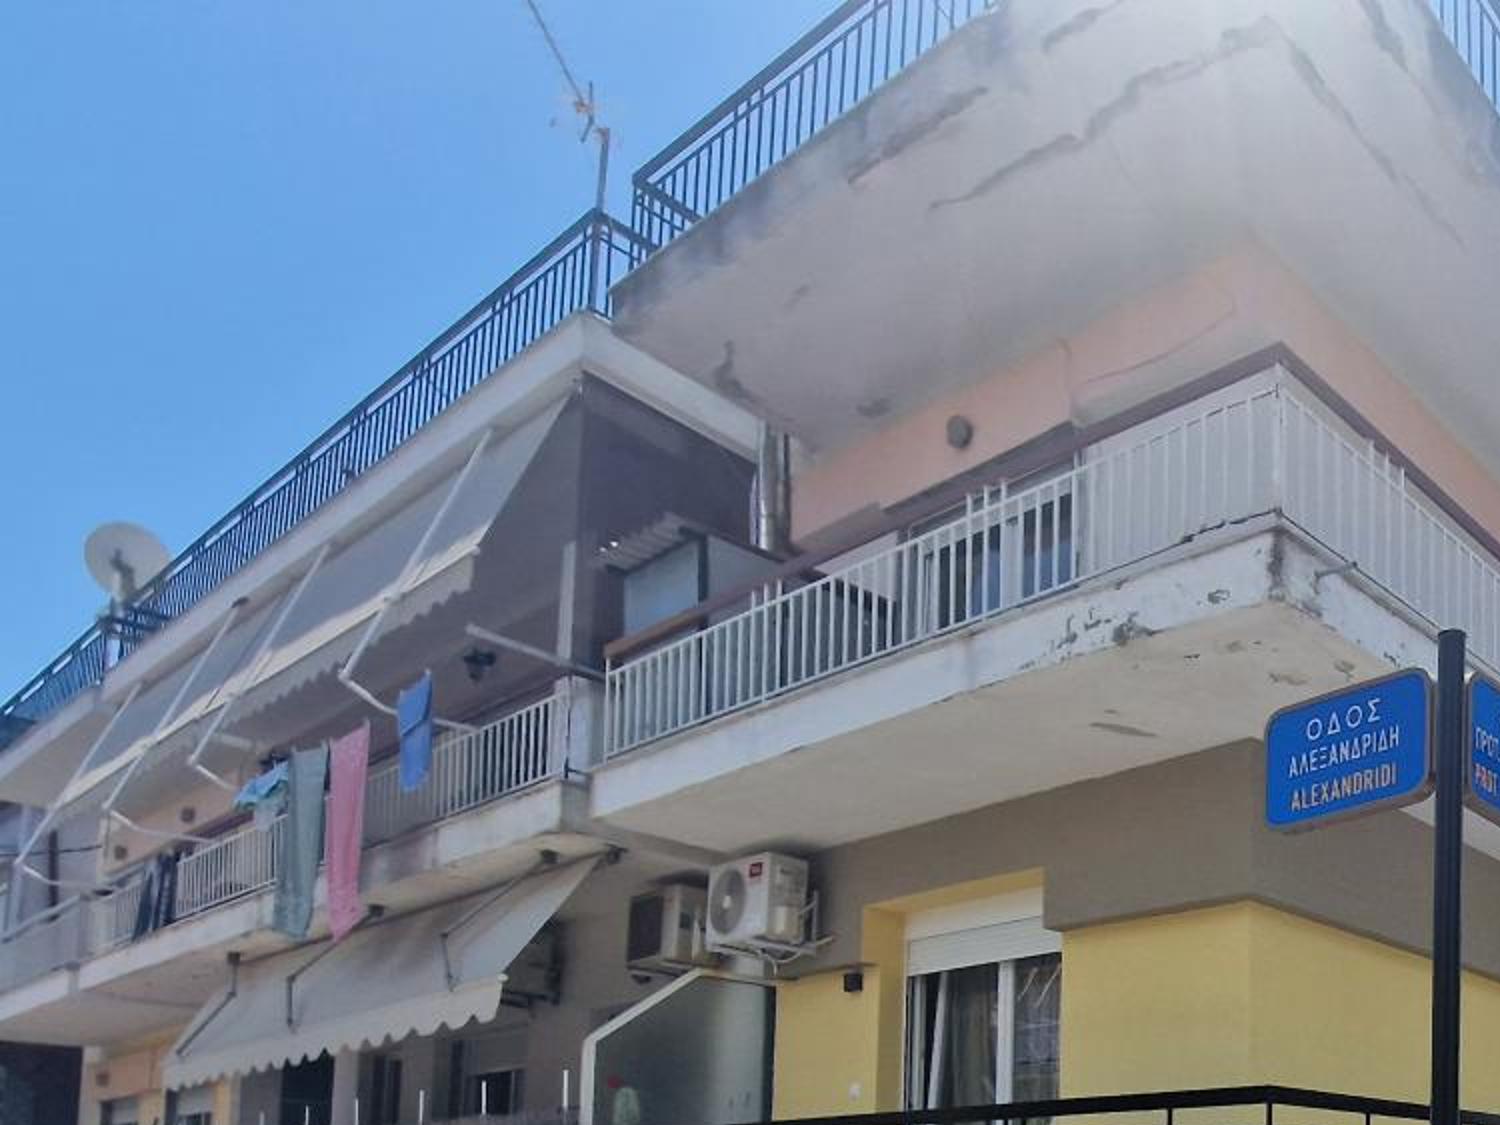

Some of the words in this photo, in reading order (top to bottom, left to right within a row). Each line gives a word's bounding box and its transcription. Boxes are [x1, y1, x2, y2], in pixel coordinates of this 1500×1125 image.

[1306, 698, 1381, 741] ΟΔΟΣ
[1288, 725, 1400, 779] ΑΛΕΞΑΝΔΡΙΔΗ
[1290, 763, 1397, 812] ALEXANDRIDI
